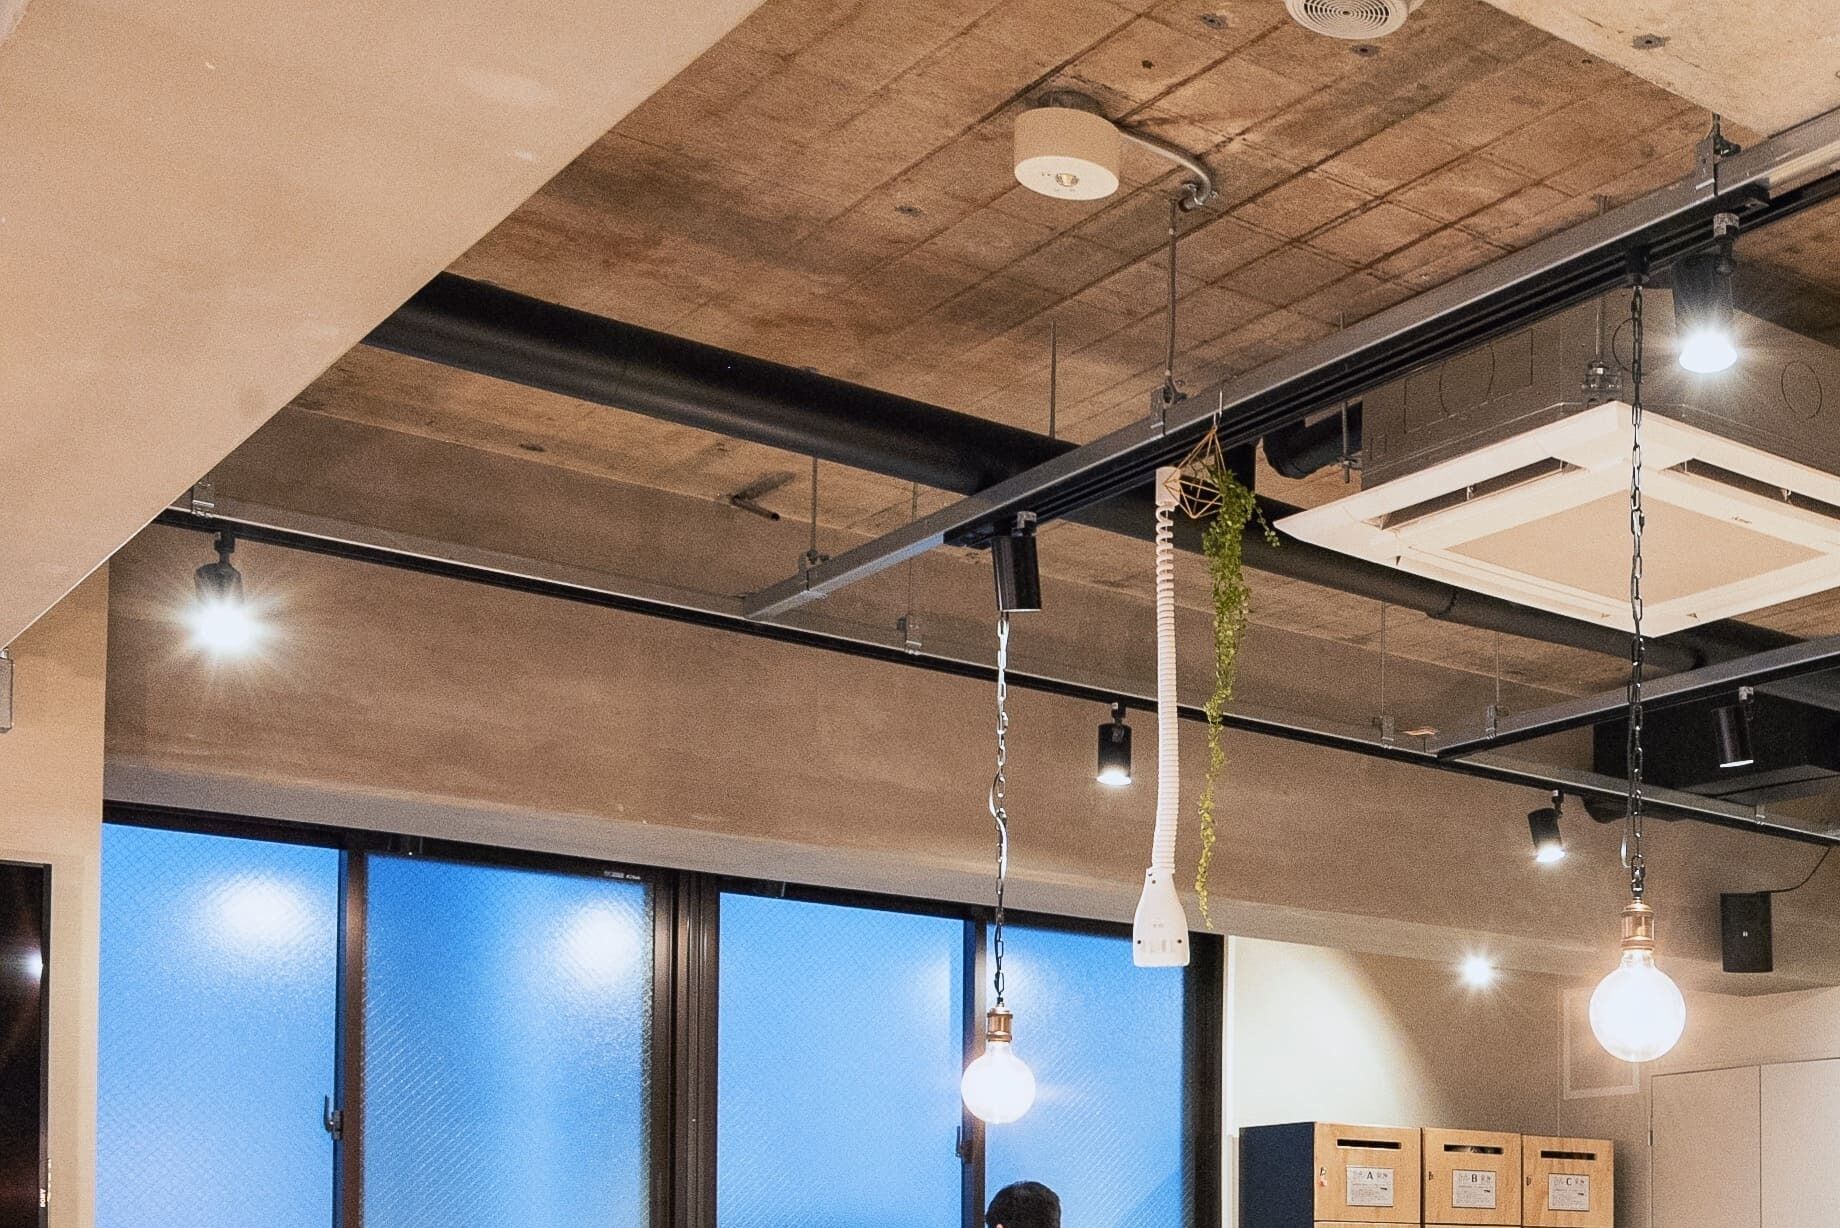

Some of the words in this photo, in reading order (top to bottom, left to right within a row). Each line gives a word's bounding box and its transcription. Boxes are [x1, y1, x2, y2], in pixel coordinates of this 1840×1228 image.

[1366, 1171, 1374, 1180] A
[1471, 1174, 1478, 1182] B
[1566, 1177, 1572, 1186] C
